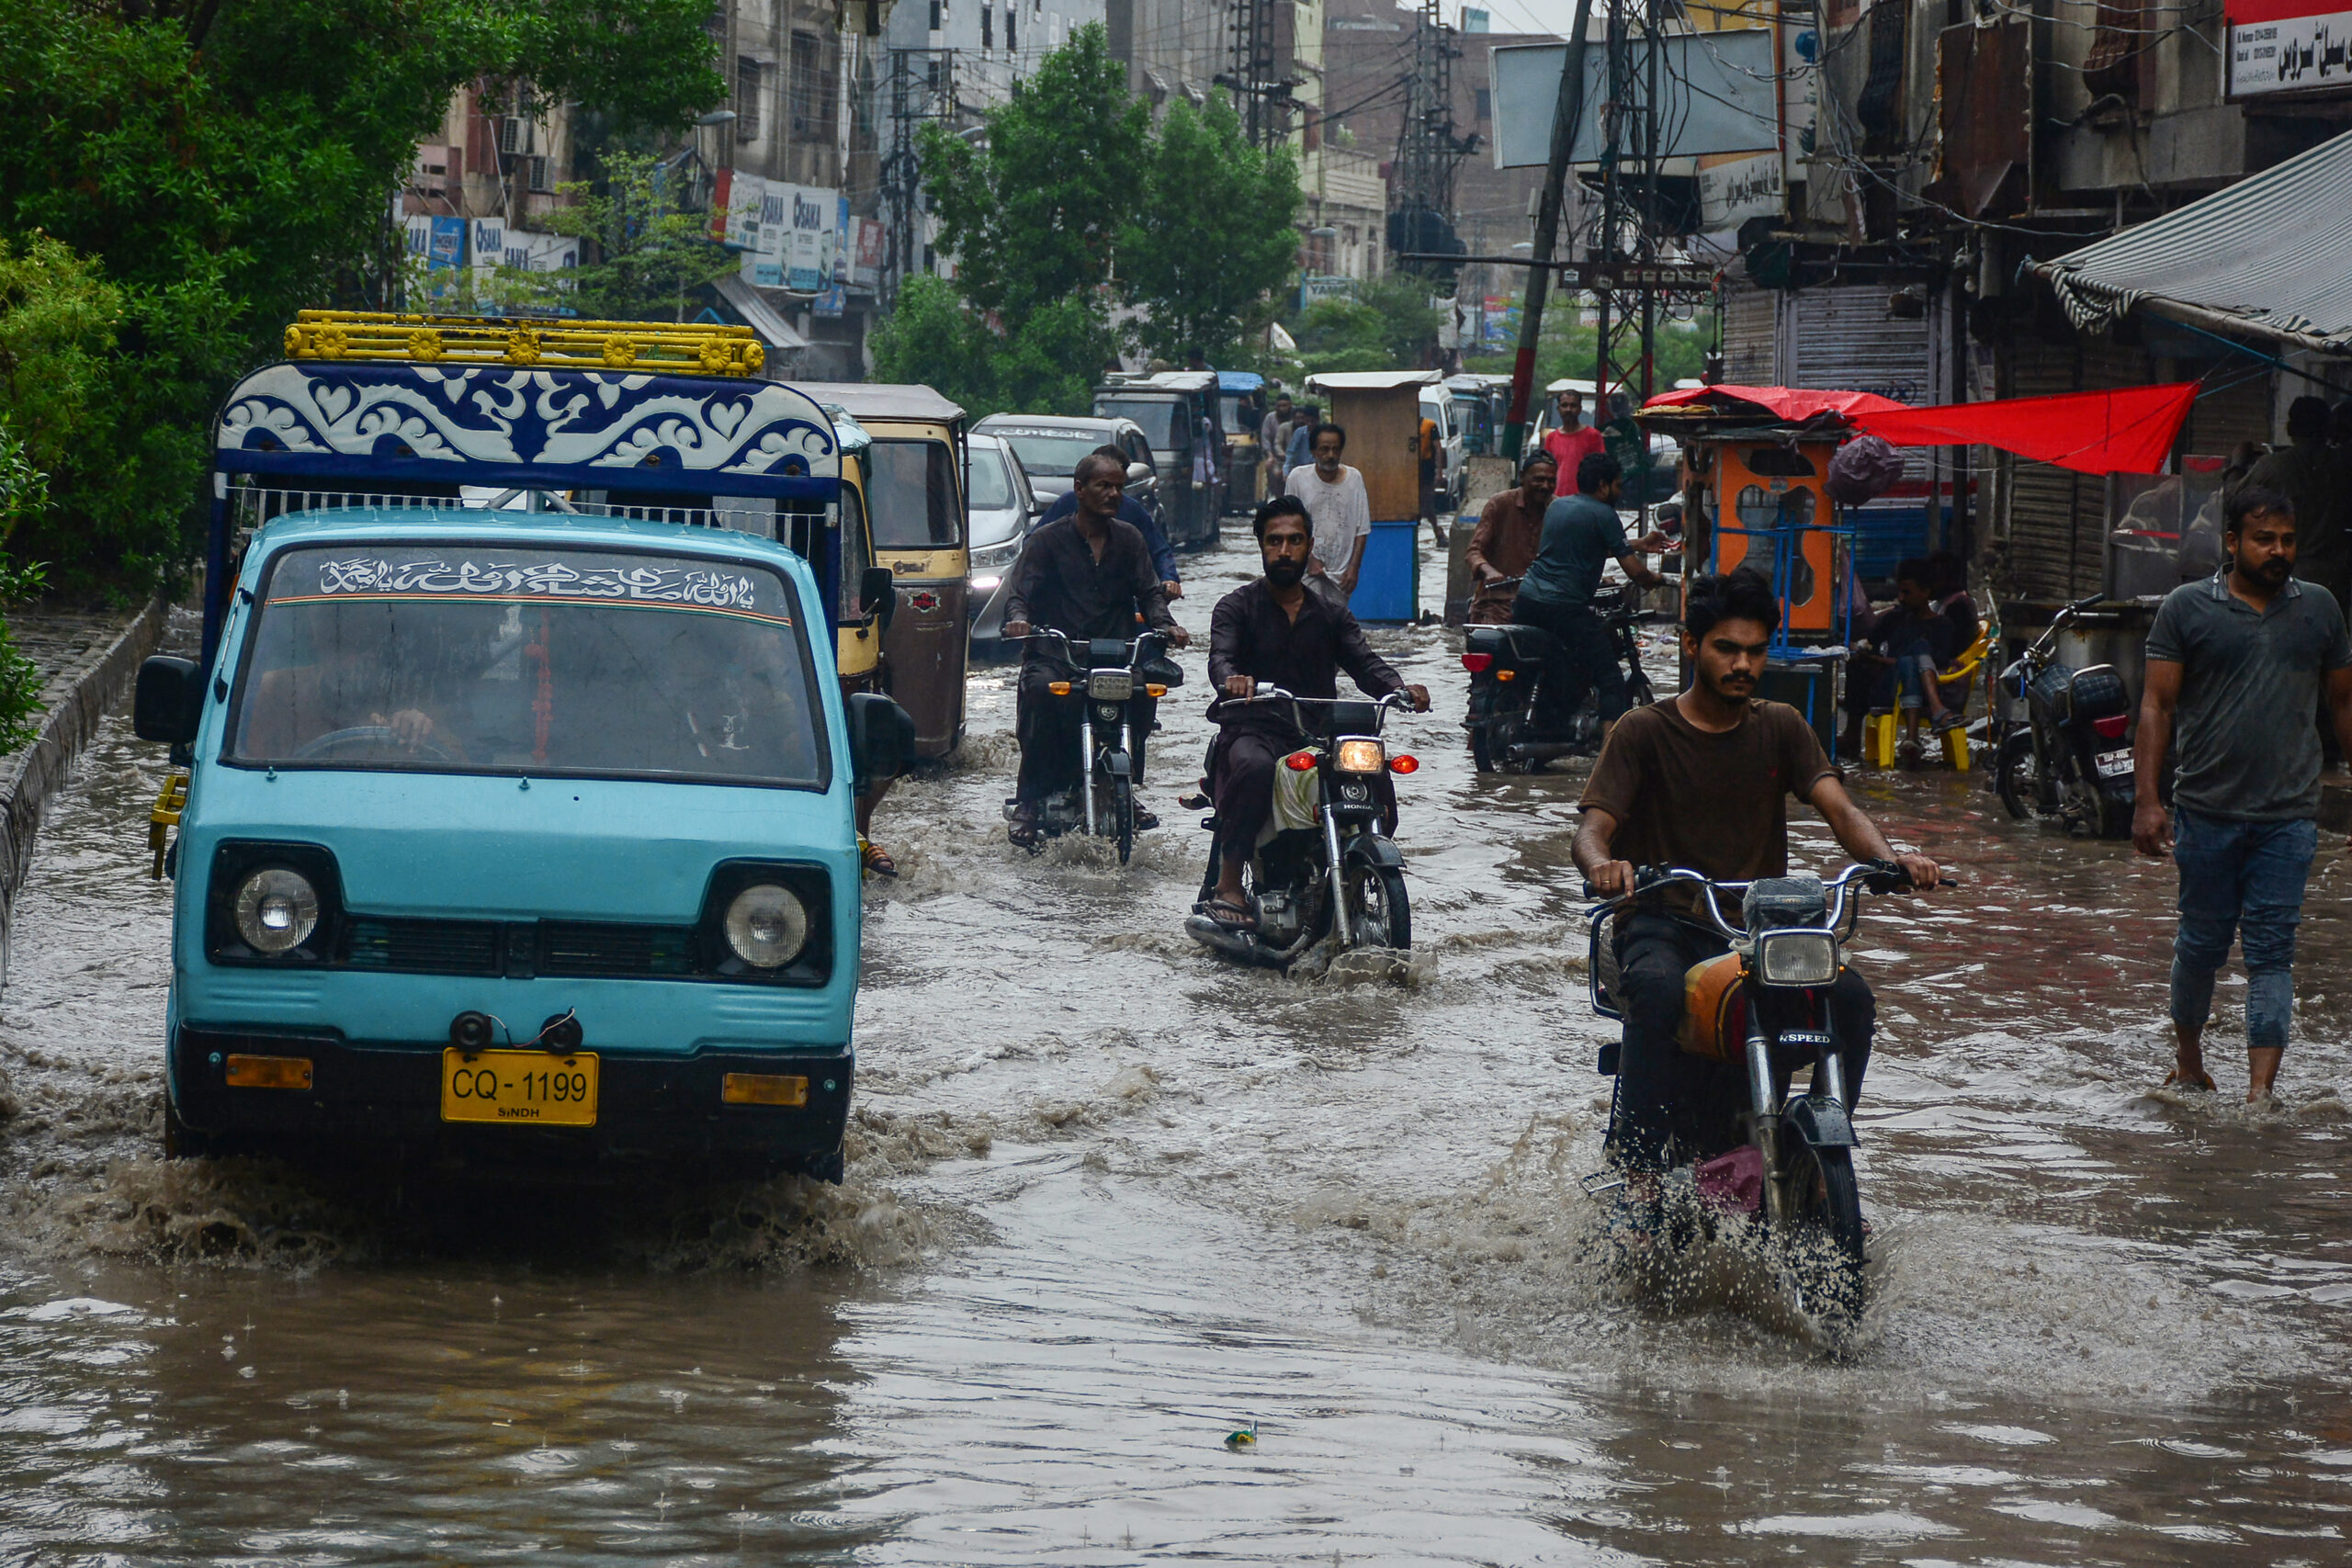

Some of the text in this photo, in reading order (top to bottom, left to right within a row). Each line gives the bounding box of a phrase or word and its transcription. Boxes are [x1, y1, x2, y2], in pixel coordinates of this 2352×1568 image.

[2278, 38, 2314, 82] سروس
[793, 192, 820, 231] OSAKA
[475, 220, 503, 254] OSAKA
[505, 246, 528, 272] SAKA
[1788, 1033, 1831, 1043] SPEED
